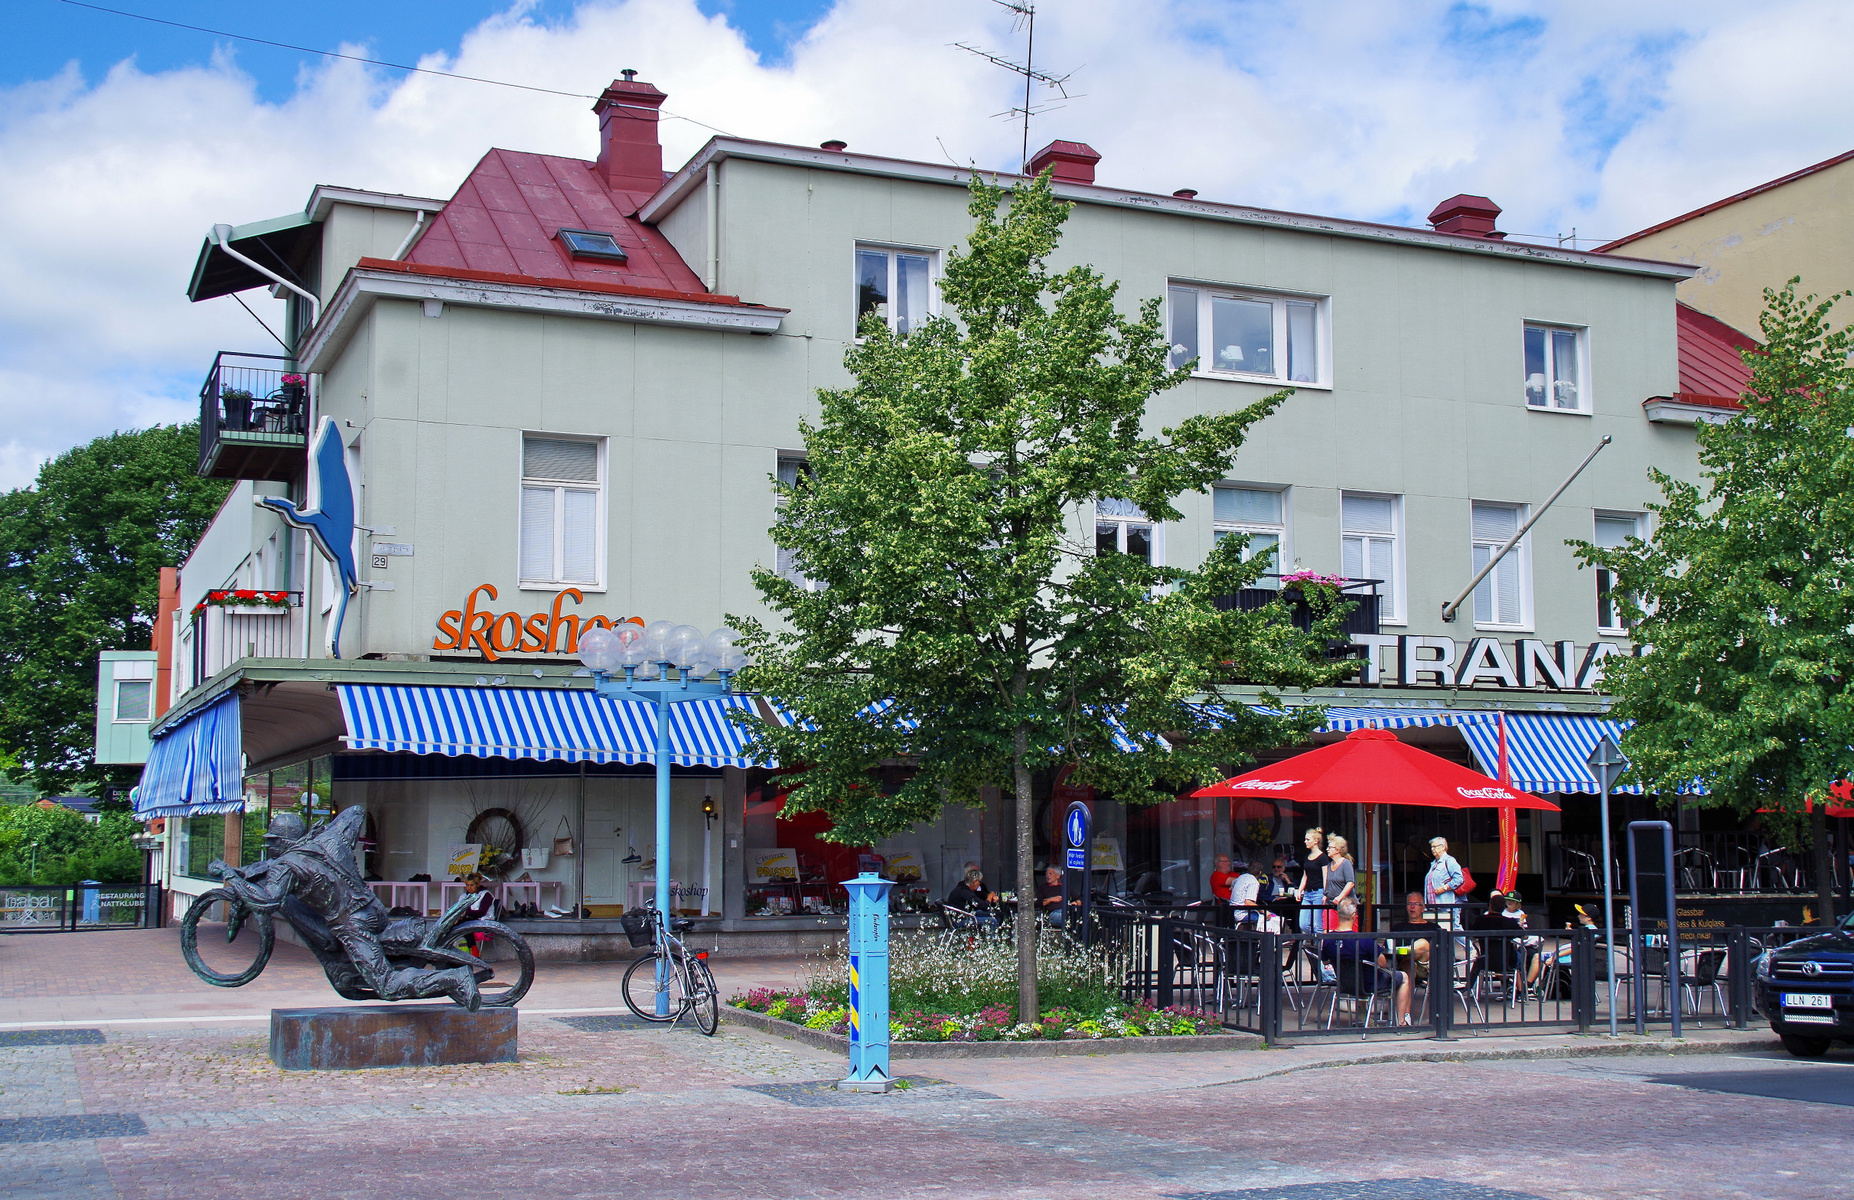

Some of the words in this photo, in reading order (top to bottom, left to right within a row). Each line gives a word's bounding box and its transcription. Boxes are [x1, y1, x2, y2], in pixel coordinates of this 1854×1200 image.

[374, 556, 386, 567] 29
[1350, 634, 1654, 690] TRANA
[1456, 786, 1517, 800] Coca-Cola
[95, 892, 145, 900] RESTAURANG
[670, 881, 709, 902] skoshop
[1676, 908, 1704, 917] Glassbar
[1690, 919, 1697, 928] &
[1698, 919, 1726, 928] Kulglass
[1786, 994, 1805, 1005] LLN
[1811, 995, 1828, 1006] 261
